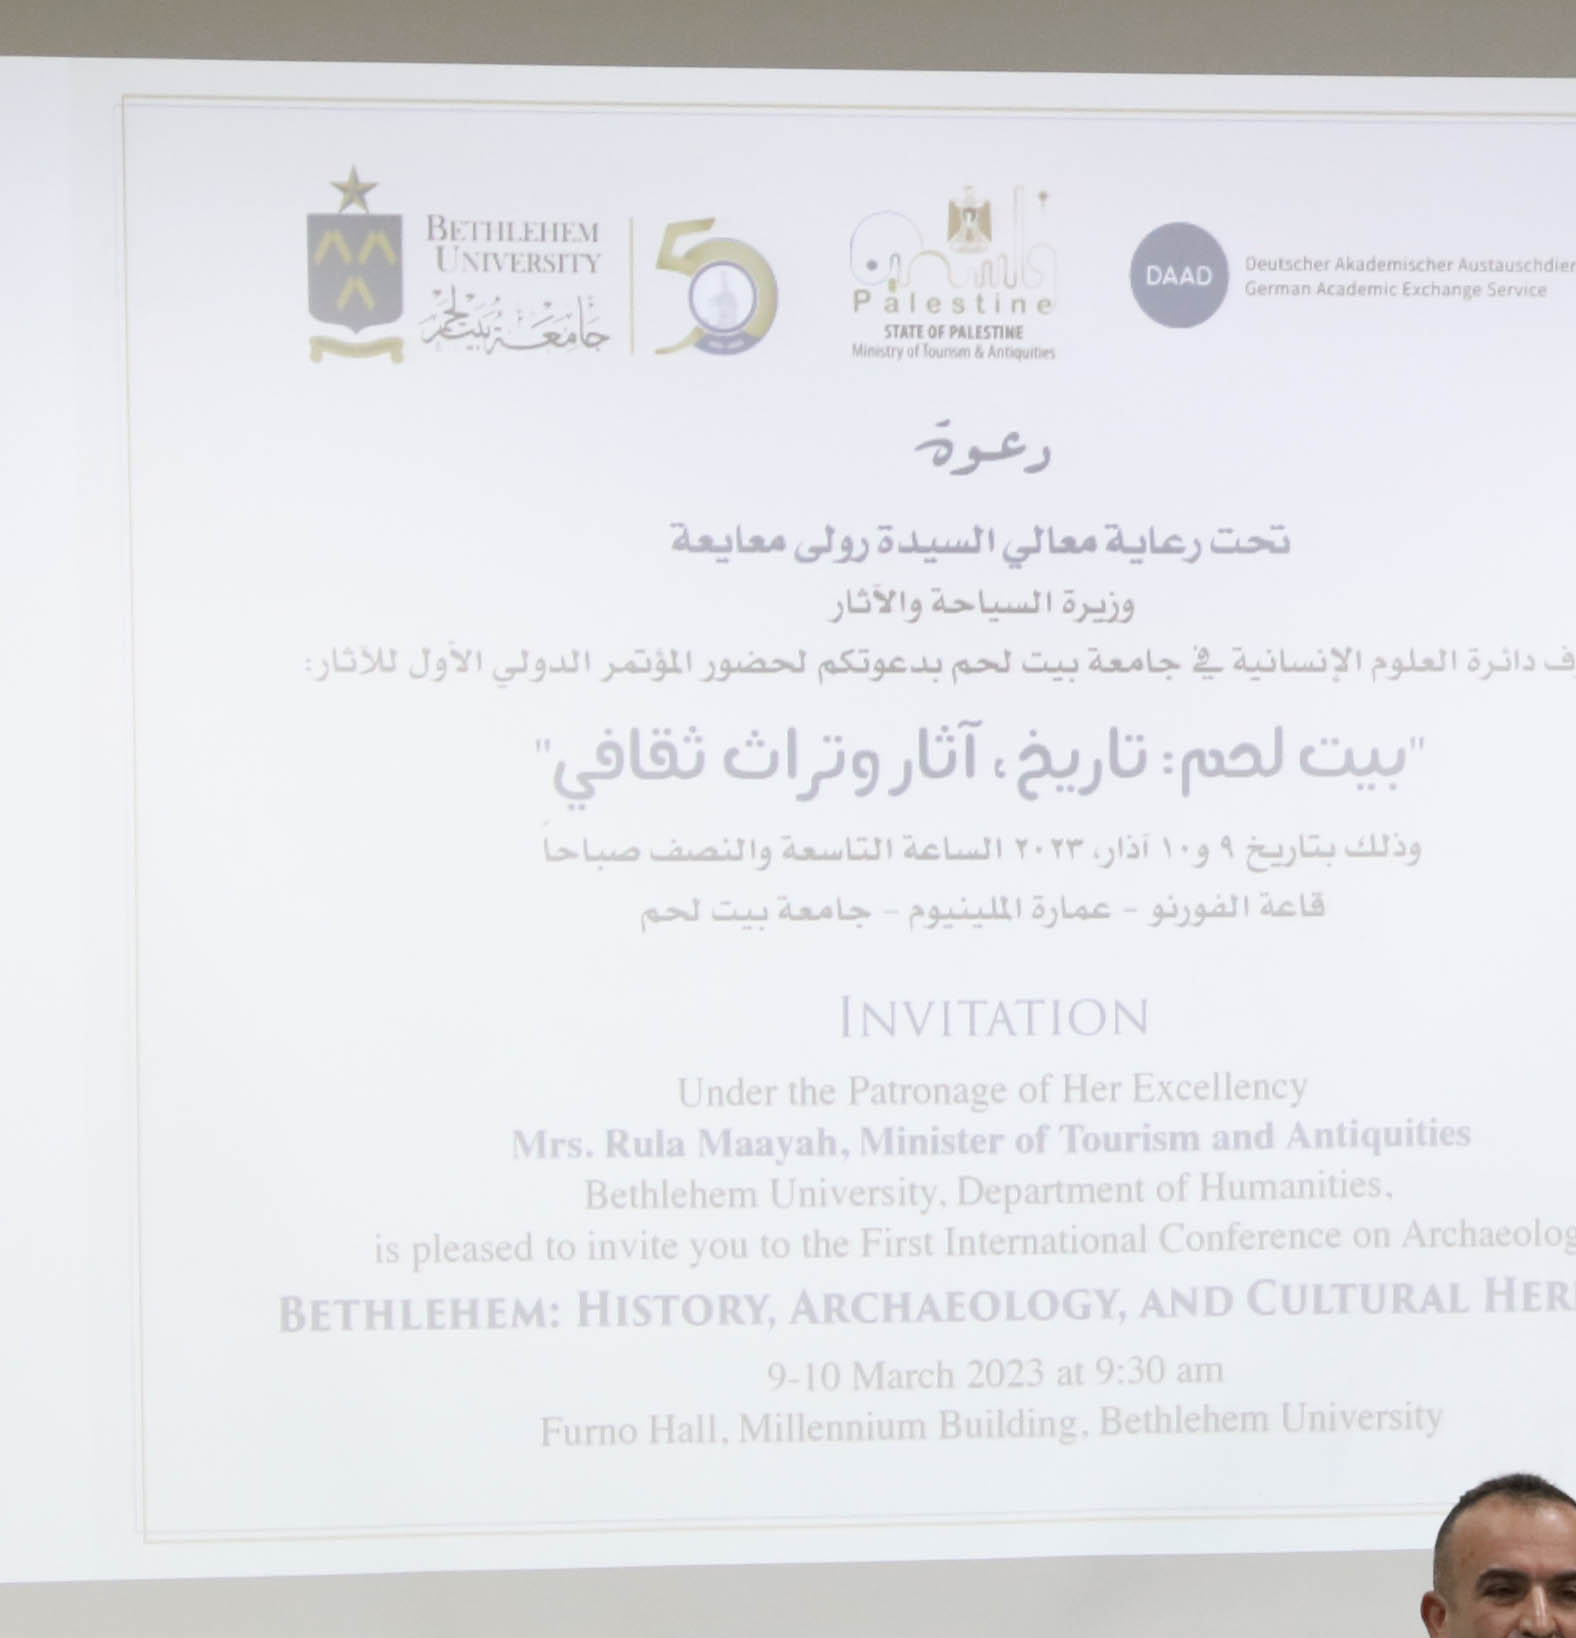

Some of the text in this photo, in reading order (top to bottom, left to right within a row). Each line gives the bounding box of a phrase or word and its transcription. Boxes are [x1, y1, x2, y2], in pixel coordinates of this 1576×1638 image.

[427, 213, 599, 243] BETHLEHEM
[436, 244, 601, 274] UNIVERSITY
[1146, 265, 1213, 287] DAAD
[1245, 255, 1331, 273] Deutscher
[1334, 255, 1454, 273] Akademischer
[853, 291, 1054, 315] Palestine
[1244, 279, 1548, 301] German Academic Exchange Service
[884, 323, 1024, 340] STATE OF PALESTINE
[851, 341, 1056, 362] Ministry of Tourism & Antiquities
[669, 522, 1291, 570] تحت رعاية معالي السيدة رولى معايعة
[951, 649, 1012, 685] لحم
[1021, 652, 1080, 683] بيت
[1087, 647, 1181, 681] جامعة
[1192, 645, 1225, 680] في
[1231, 645, 1362, 683] الإنسانية
[1370, 647, 1457, 684] العلوم
[1466, 647, 1536, 681] دائرة
[841, 995, 1148, 1038] INVITATION
[677, 1071, 1308, 1113] Under the Patronage of Her Excellency
[513, 1116, 1472, 1167] Mrs. Rula Maayah, Minister of Tourism and Antiquities
[585, 1178, 757, 1210] Bethlehem
[958, 1175, 1145, 1215] Department
[1156, 1171, 1191, 1203] of
[375, 1233, 400, 1264] is
[412, 1231, 534, 1274] pleased
[545, 1236, 577, 1262] to
[588, 1229, 679, 1261] invite
[689, 1237, 749, 1269] you
[760, 1234, 791, 1259] to
[801, 1228, 849, 1259] the
[860, 1227, 934, 1258] First
[946, 1223, 1147, 1257] International
[1158, 1221, 1342, 1254] Conference
[1352, 1226, 1391, 1249] on
[279, 1295, 560, 1333] BETHLEHEM:
[577, 1289, 777, 1330] HISTORY,
[788, 1287, 1127, 1325] ARCHAEOLOGY,
[1139, 1285, 1234, 1319] AND
[1246, 1278, 1470, 1317] CULTURAL
[767, 1354, 1224, 1393] 9-10 March 2023 at 9:30 am
[541, 1416, 638, 1448] Furno
[739, 1411, 927, 1444] Millennium
[1100, 1403, 1270, 1436] Bethlehem
[1282, 1400, 1444, 1439] University
